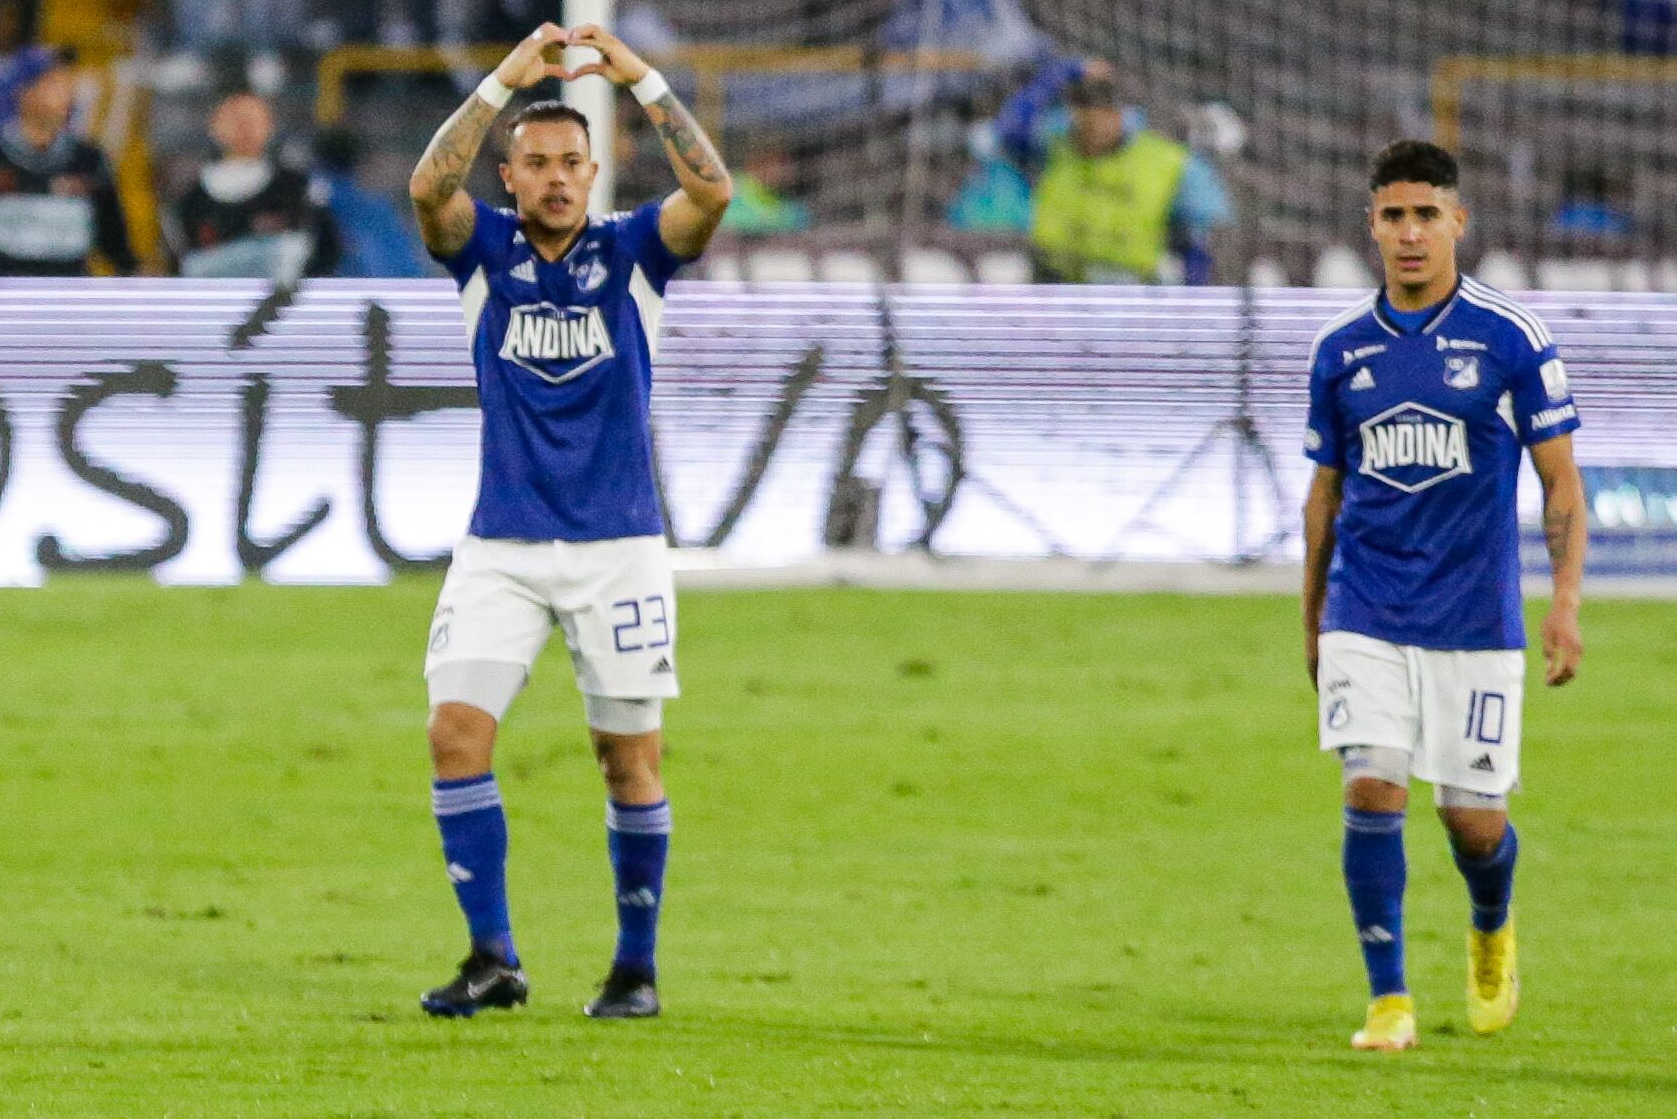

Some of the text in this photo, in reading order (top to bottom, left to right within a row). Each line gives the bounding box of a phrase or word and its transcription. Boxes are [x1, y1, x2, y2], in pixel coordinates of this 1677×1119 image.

[502, 310, 613, 359] ANDINA
[1361, 422, 1471, 473] ANDINA
[612, 594, 669, 653] 23
[1465, 689, 1505, 744] 10
